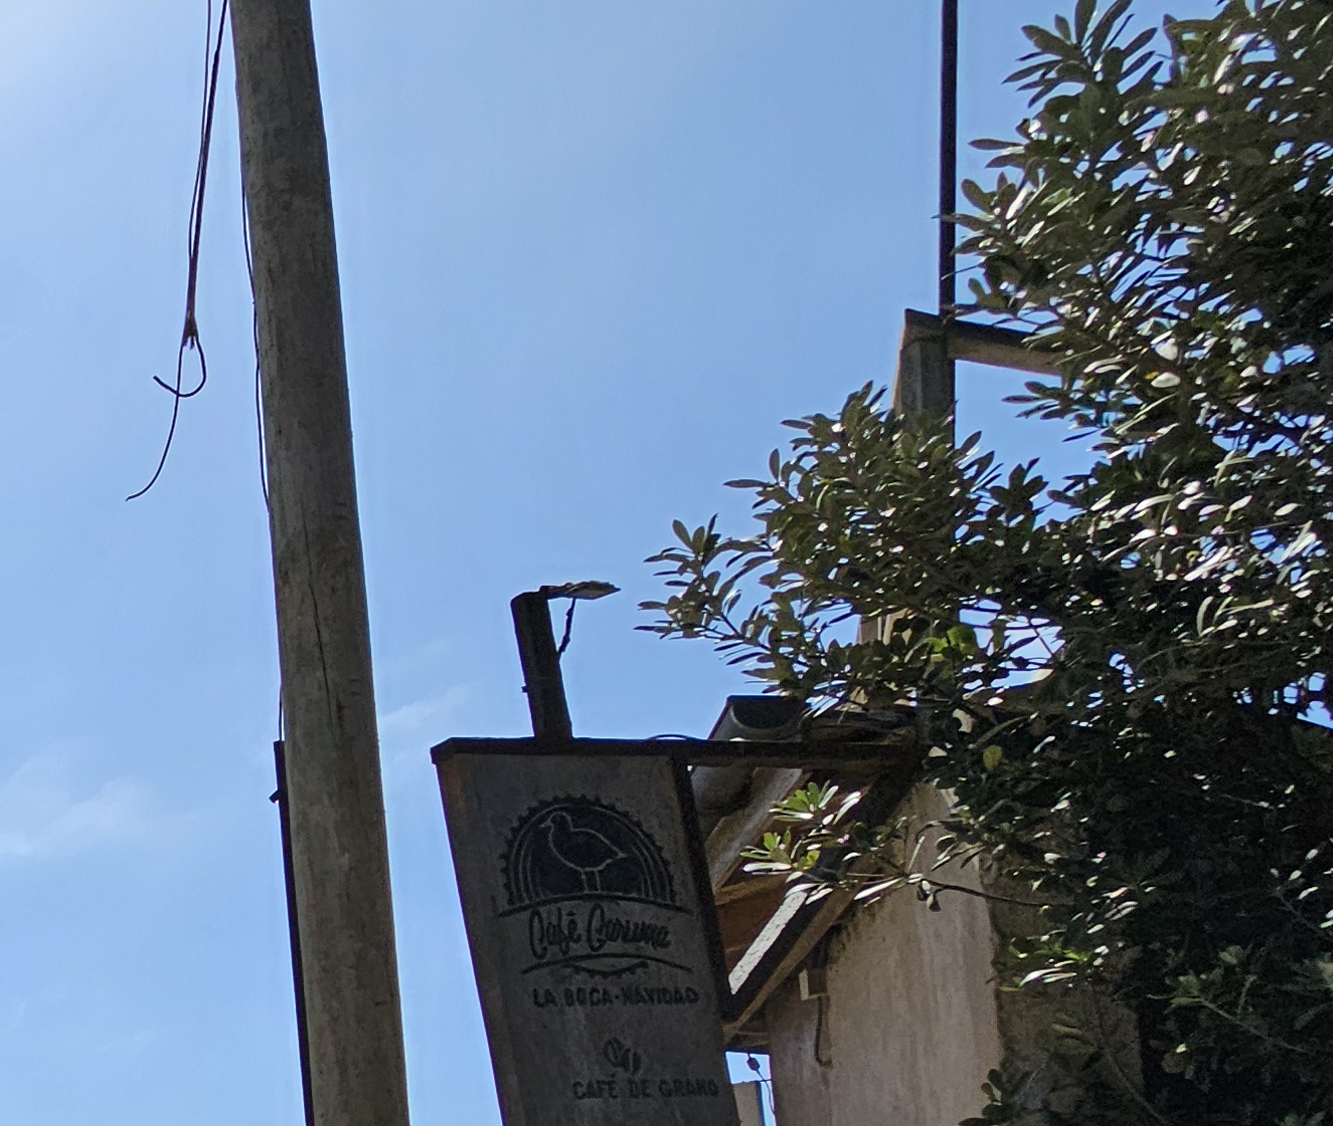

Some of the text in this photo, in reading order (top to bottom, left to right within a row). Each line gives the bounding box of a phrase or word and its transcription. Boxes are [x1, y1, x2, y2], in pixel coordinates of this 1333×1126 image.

[529, 906, 582, 960] Café
[571, 1073, 720, 1099] CAFÉ DE GRANO
